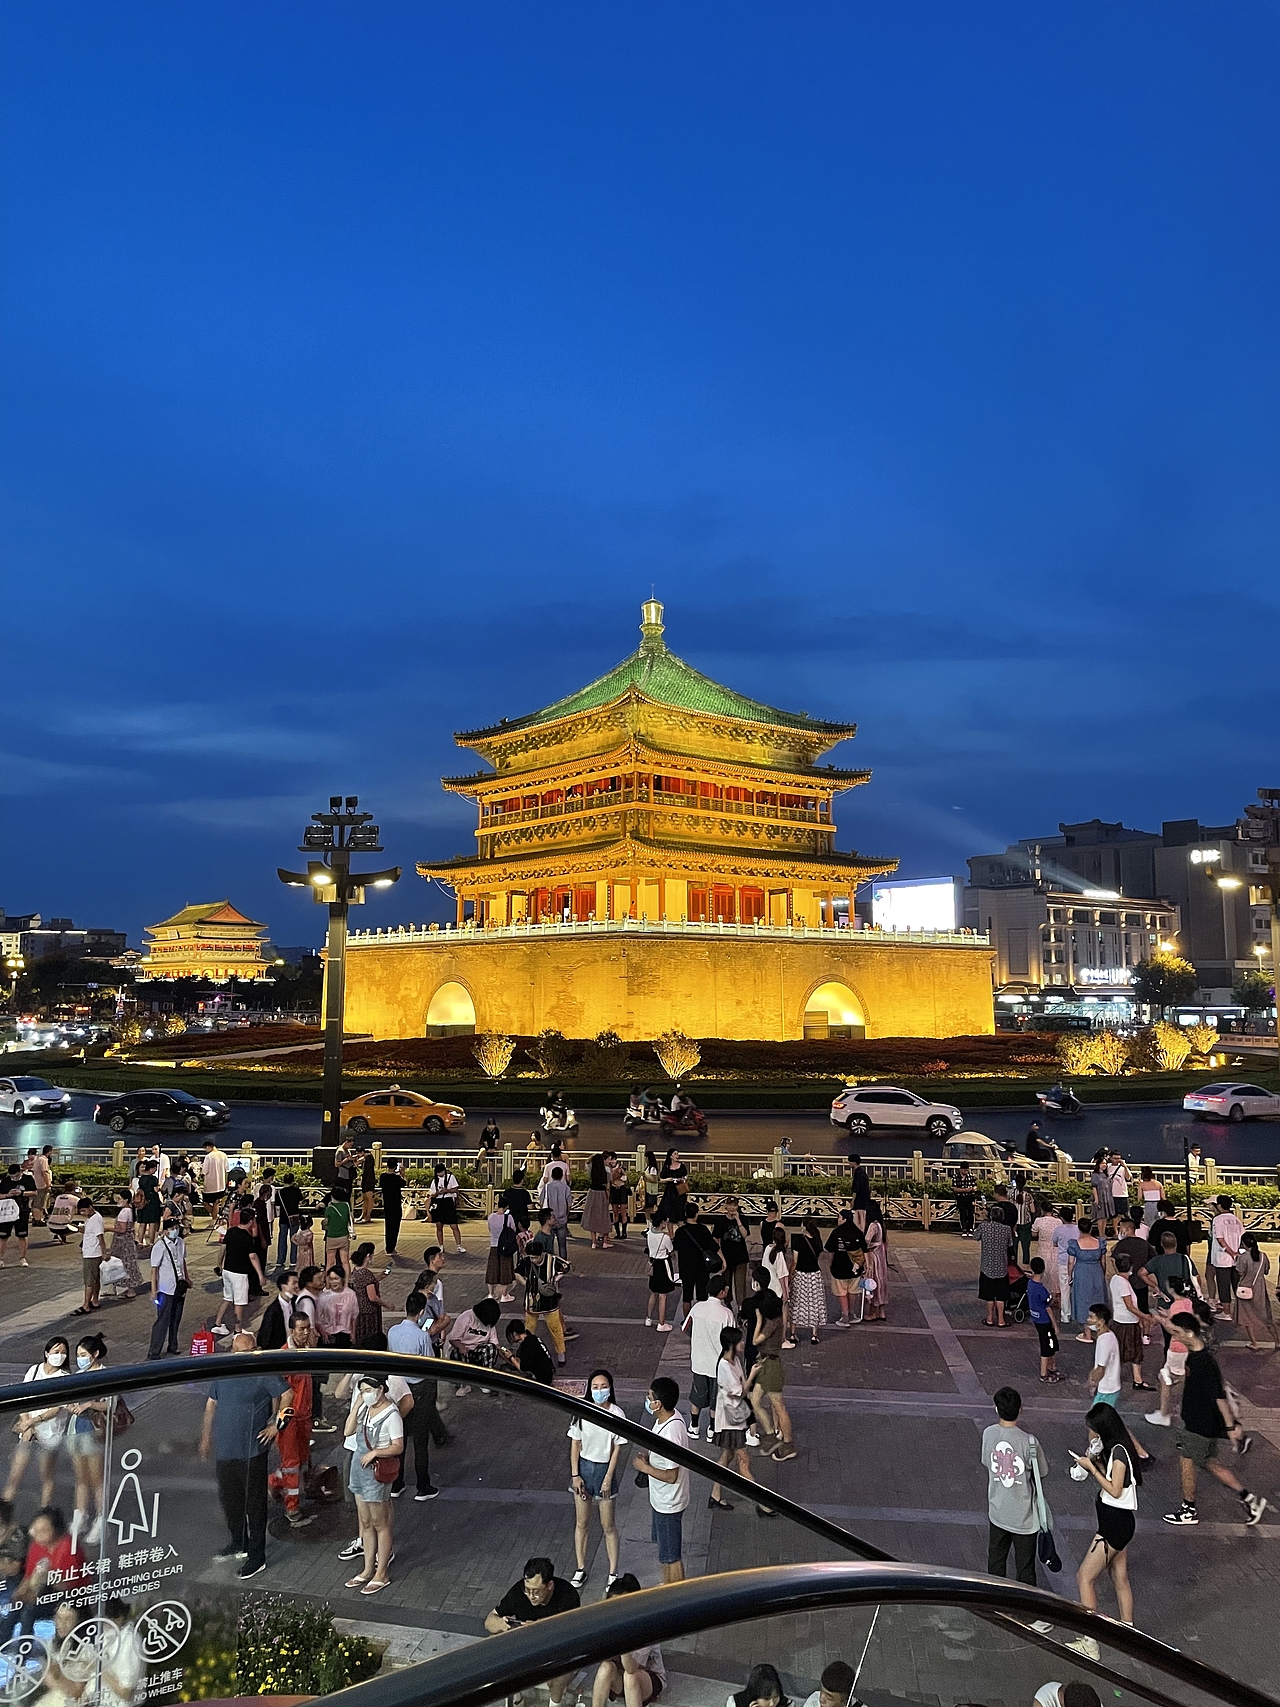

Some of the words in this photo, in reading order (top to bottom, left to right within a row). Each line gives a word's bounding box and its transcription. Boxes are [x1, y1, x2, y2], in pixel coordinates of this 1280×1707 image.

[46, 1558, 111, 1586] 防止长裙
[118, 1544, 179, 1570] 鞋带卷入
[36, 1591, 64, 1606] KEEP
[65, 1583, 100, 1599] LOOSE
[101, 1571, 150, 1591] CLOTHING
[151, 1564, 183, 1579] CLEAR
[60, 1600, 75, 1611] OF
[75, 1592, 108, 1608] STEPS
[109, 1586, 131, 1600] AND
[131, 1580, 160, 1595] SIDES
[133, 1691, 148, 1702] NO
[148, 1681, 183, 1698] WHEELS
[136, 1667, 183, 1691] 禁止推车
